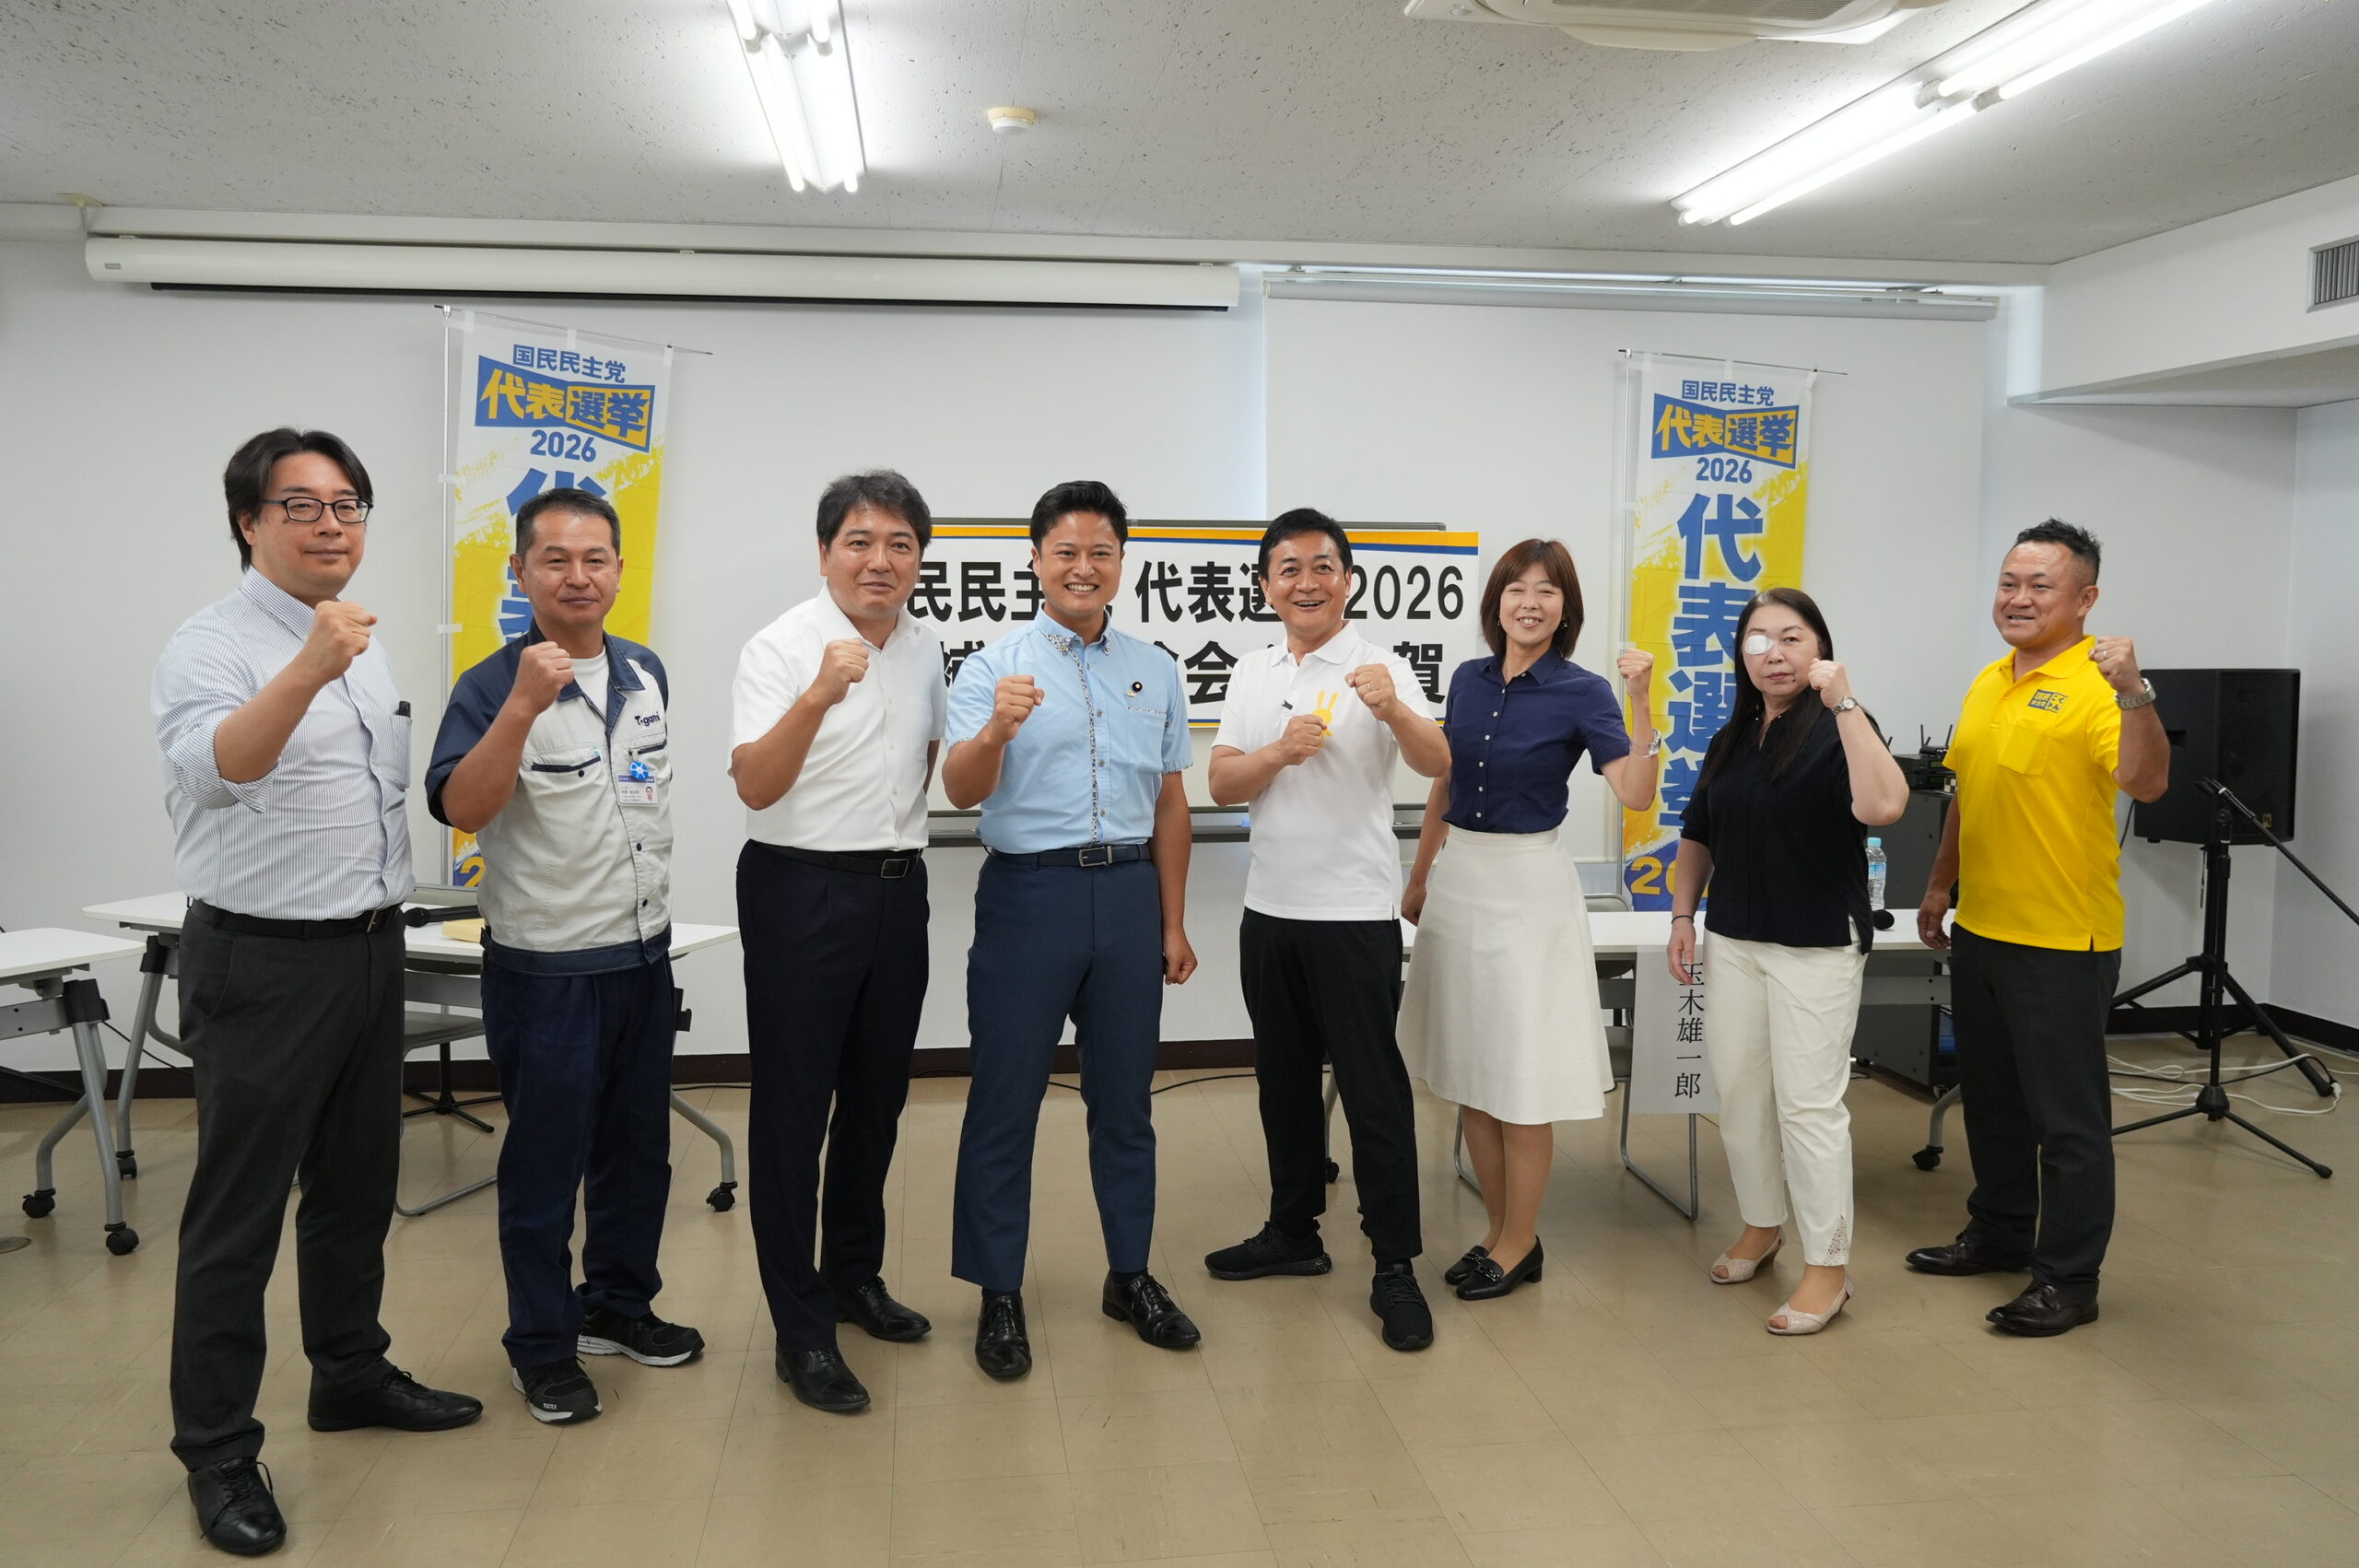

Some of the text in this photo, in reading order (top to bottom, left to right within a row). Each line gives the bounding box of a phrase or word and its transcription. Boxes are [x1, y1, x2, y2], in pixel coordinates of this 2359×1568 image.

[512, 344, 626, 383] 国民民主党
[480, 369, 649, 438] 代表選挙
[1682, 380, 1775, 406] 国民民主党
[530, 429, 596, 462] 2026
[1656, 404, 1794, 457] 代表選挙
[1696, 457, 1753, 484] 2026
[907, 561, 1112, 622] 民民主
[1344, 565, 1463, 619] 2026
